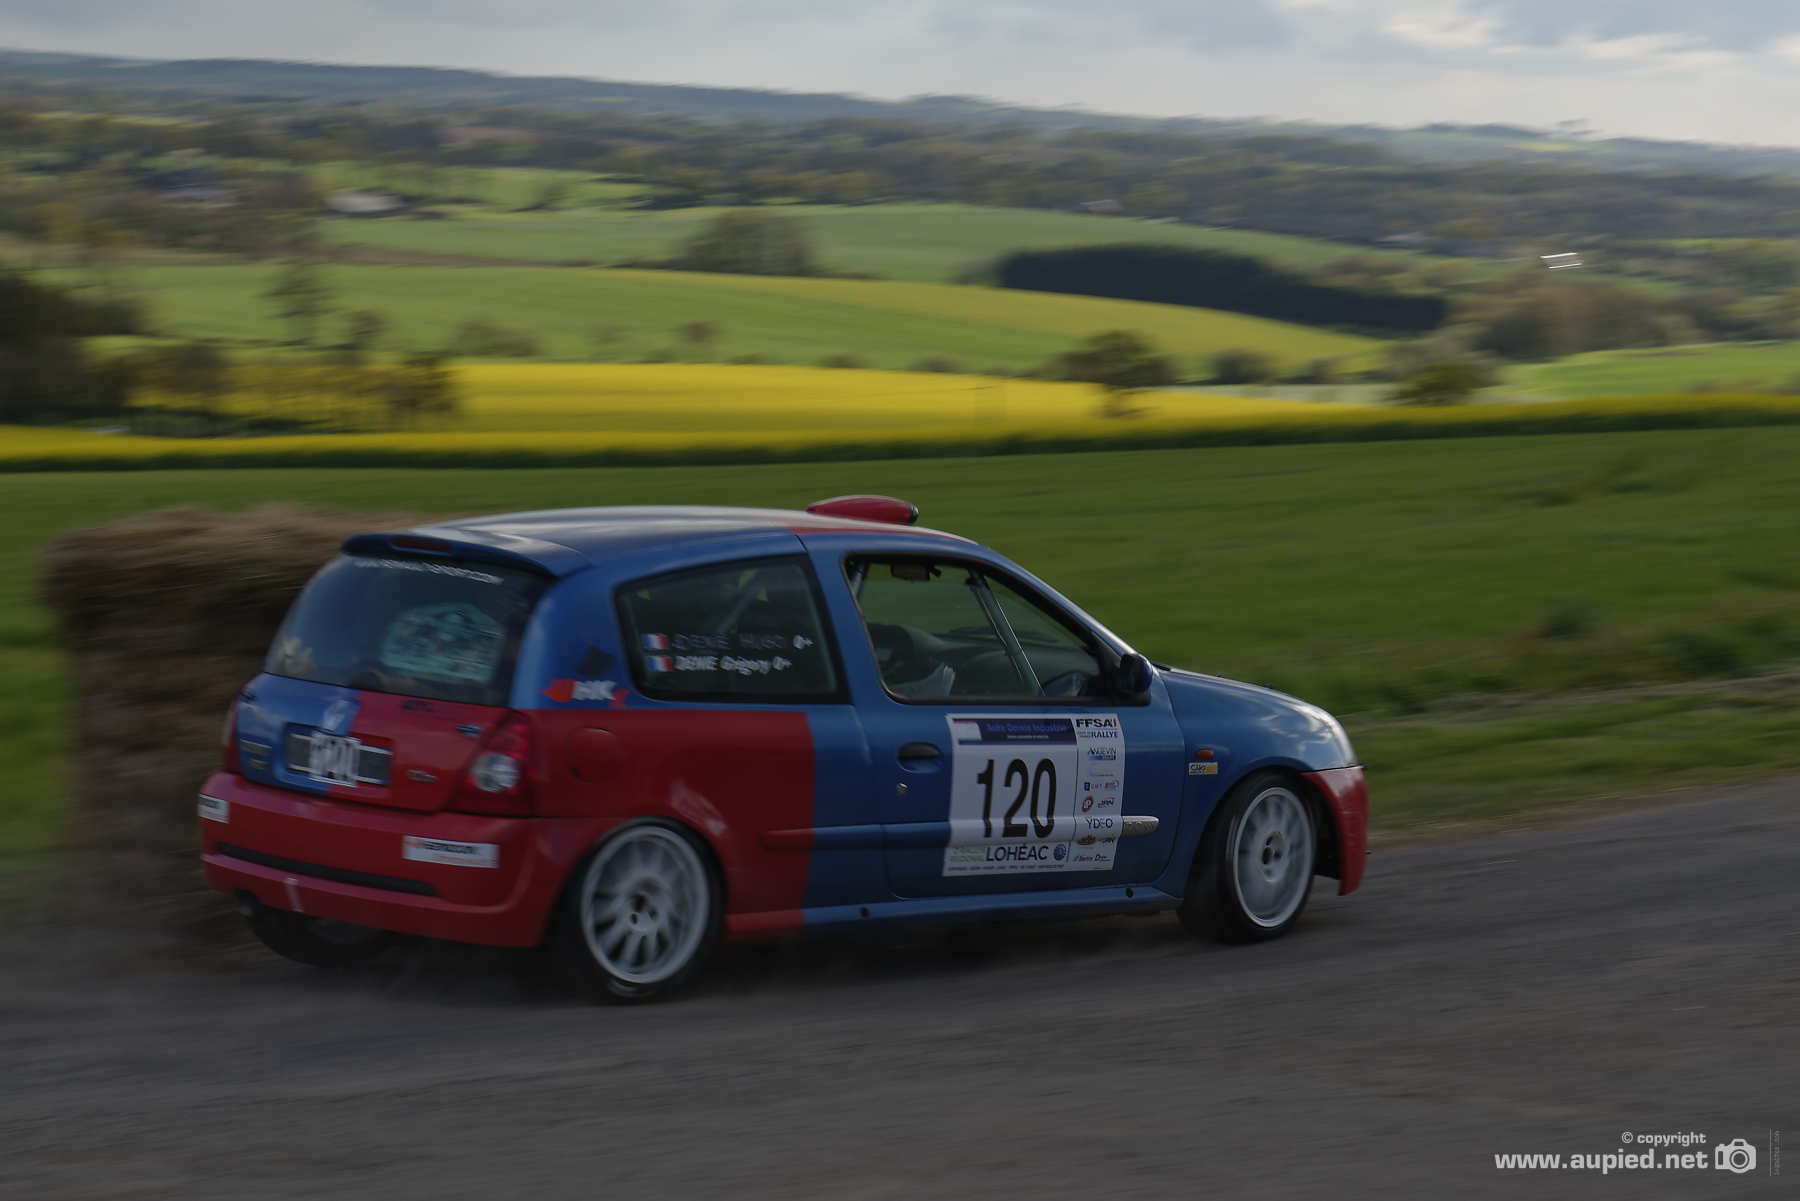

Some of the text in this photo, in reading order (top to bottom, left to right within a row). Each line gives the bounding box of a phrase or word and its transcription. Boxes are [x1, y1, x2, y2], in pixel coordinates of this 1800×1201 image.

[1075, 718, 1114, 728] FFSA
[1091, 730, 1118, 738] RALLYE
[976, 758, 1057, 838] 120
[985, 842, 1049, 862] LOHÉAC
